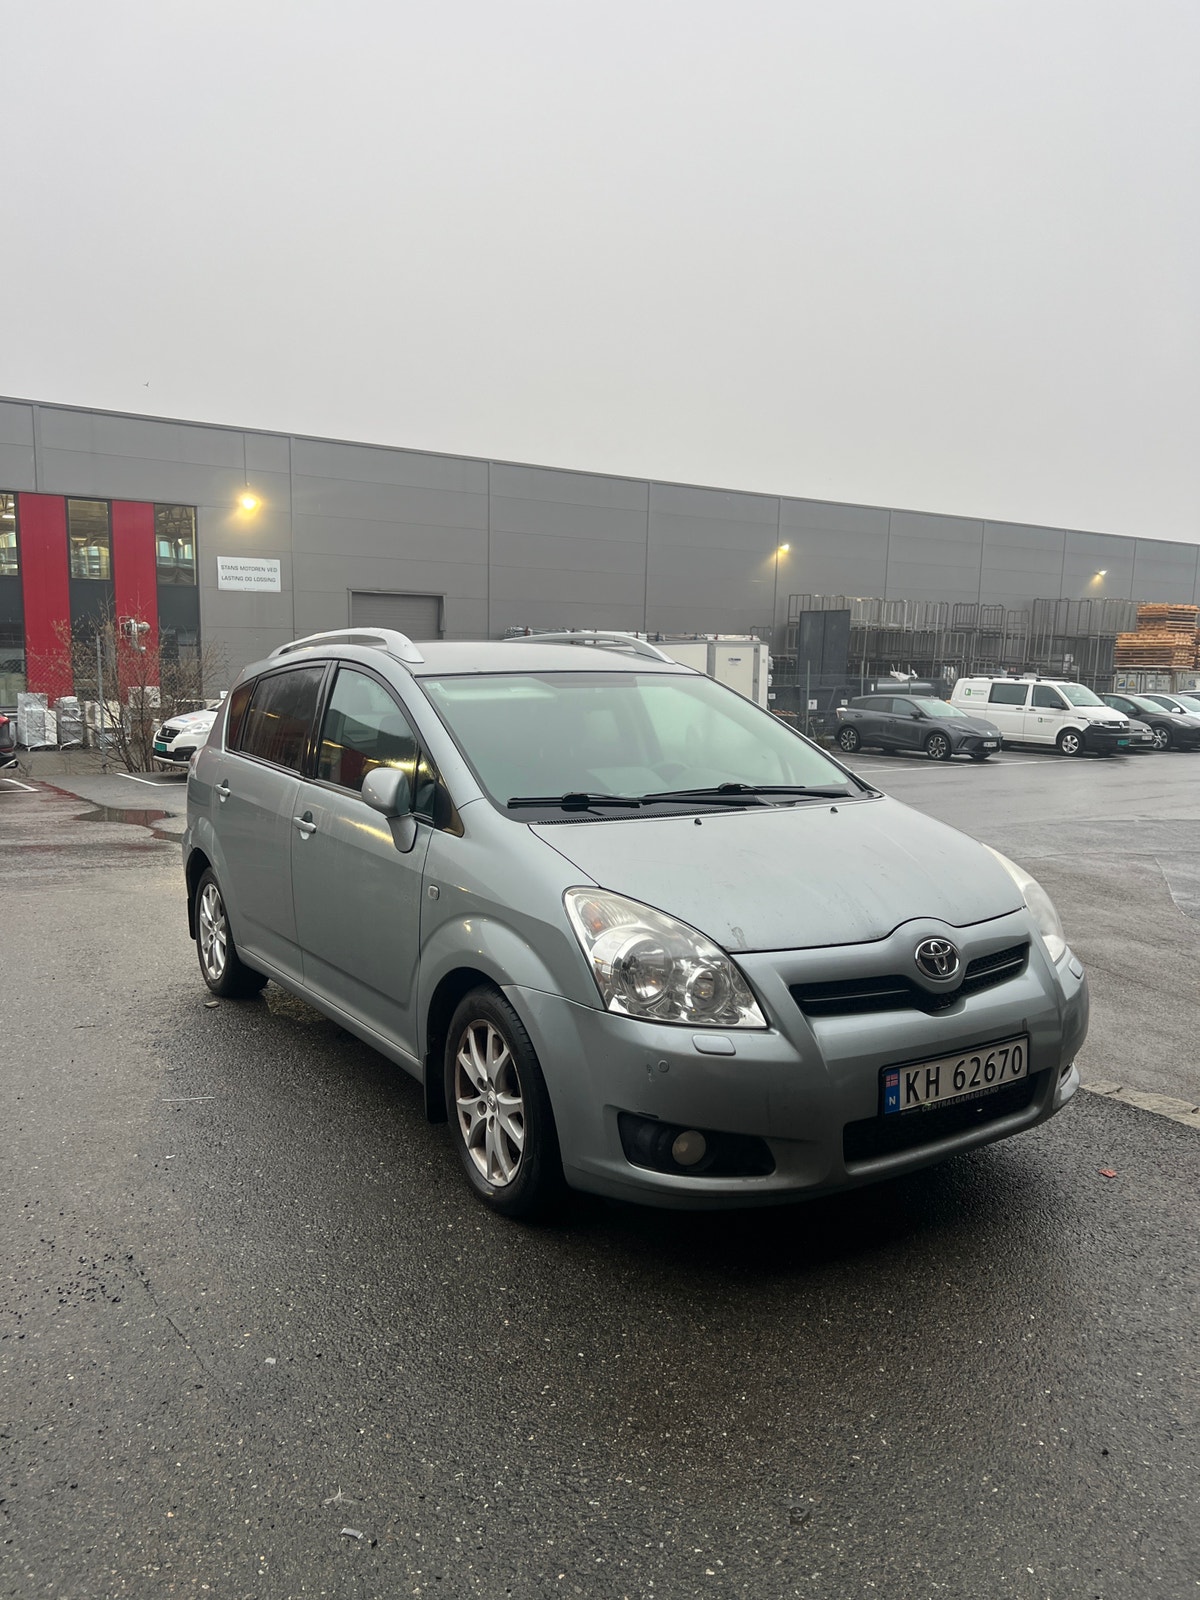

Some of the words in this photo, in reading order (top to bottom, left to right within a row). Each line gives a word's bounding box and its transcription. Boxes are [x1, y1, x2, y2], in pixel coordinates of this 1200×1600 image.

[905, 1066, 941, 1104] KH
[953, 1045, 1023, 1091] 62670
[888, 1095, 896, 1106] N
